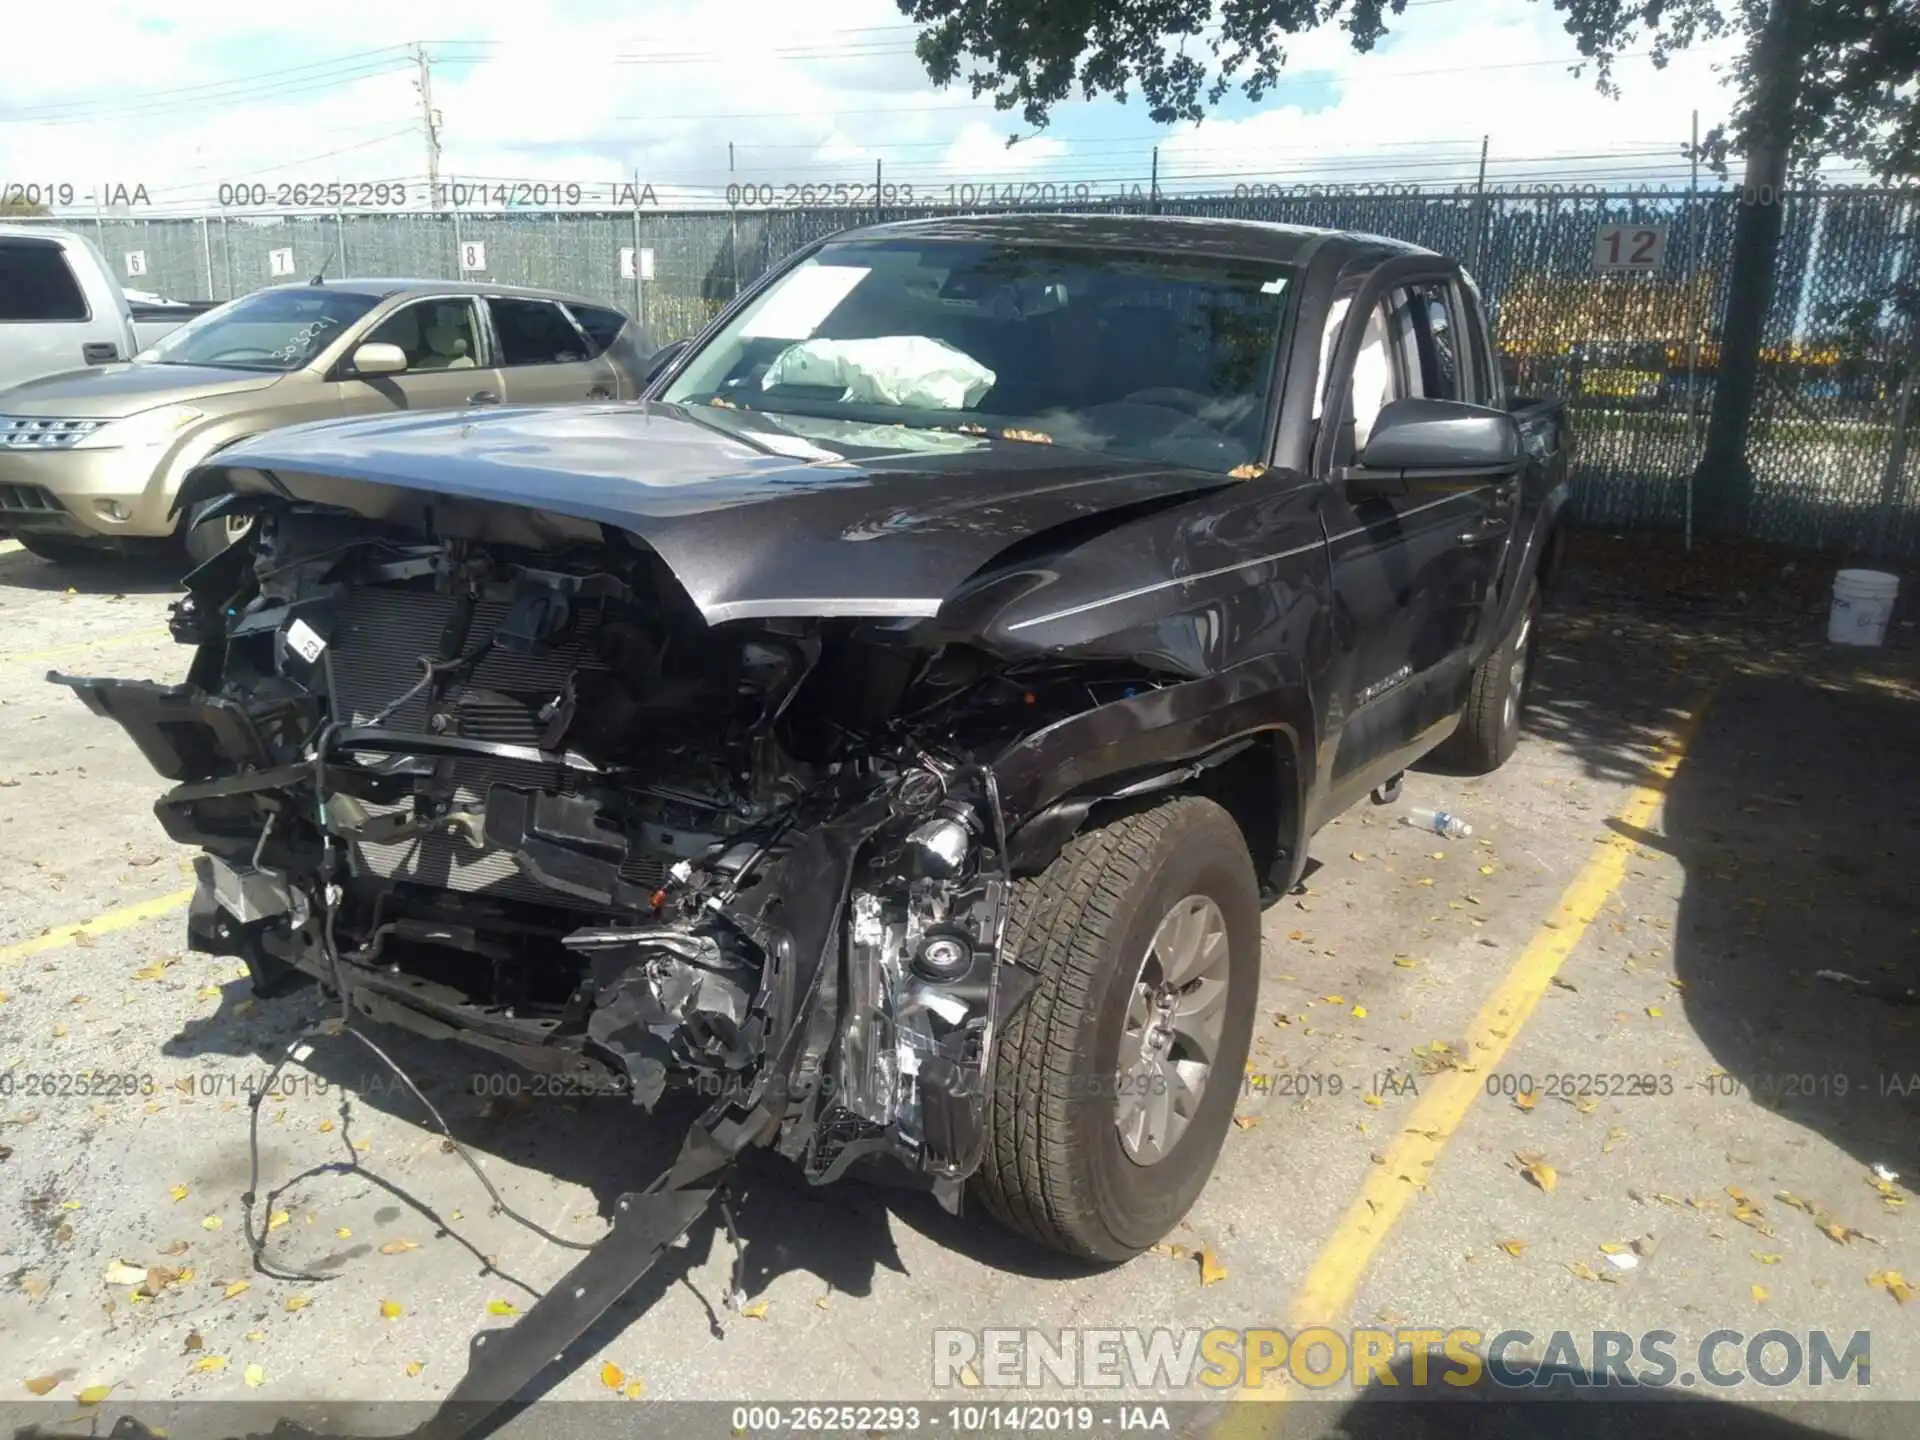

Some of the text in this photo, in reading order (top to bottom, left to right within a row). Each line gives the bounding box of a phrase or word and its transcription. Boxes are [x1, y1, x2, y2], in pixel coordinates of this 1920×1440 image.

[466, 246, 477, 266] 8
[1603, 230, 1657, 263] 12
[131, 255, 141, 272] 6
[275, 252, 286, 271] 7
